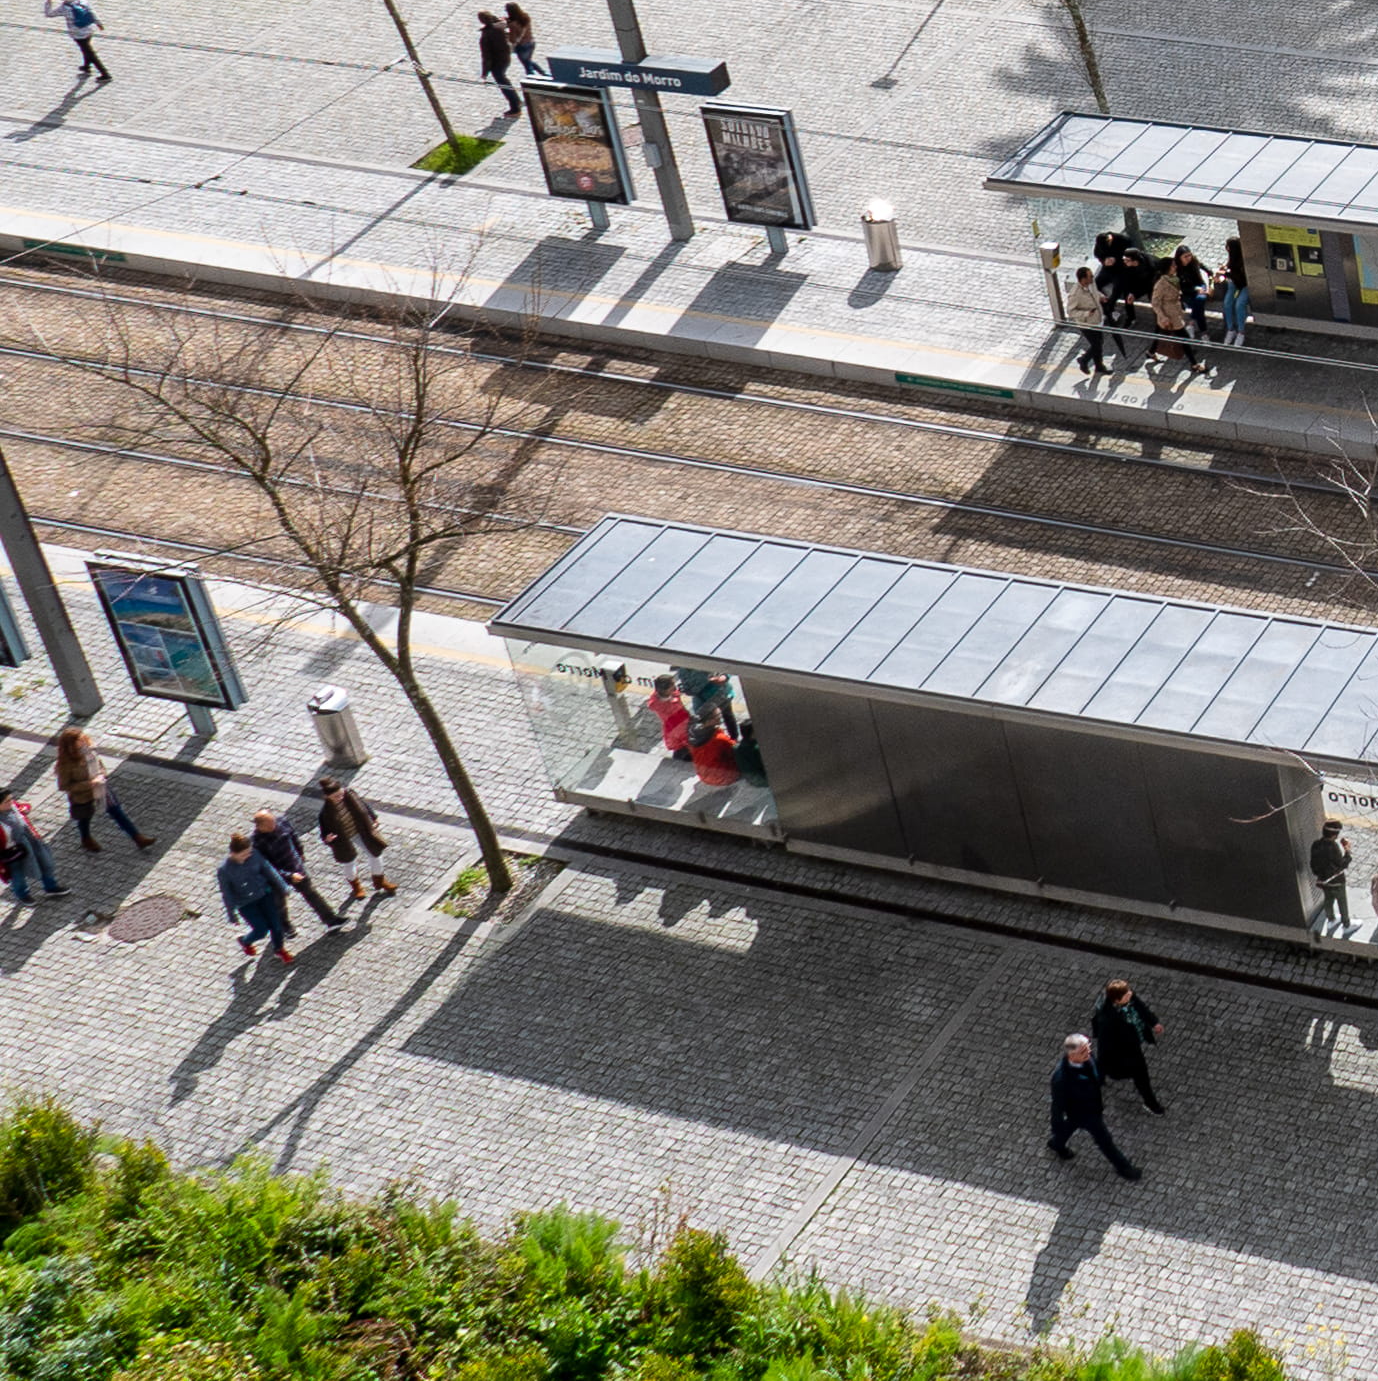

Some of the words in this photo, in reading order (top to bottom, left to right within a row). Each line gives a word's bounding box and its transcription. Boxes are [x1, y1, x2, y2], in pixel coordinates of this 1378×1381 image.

[578, 66, 621, 83] Jardim
[624, 71, 642, 85] do
[643, 72, 682, 88] Morro
